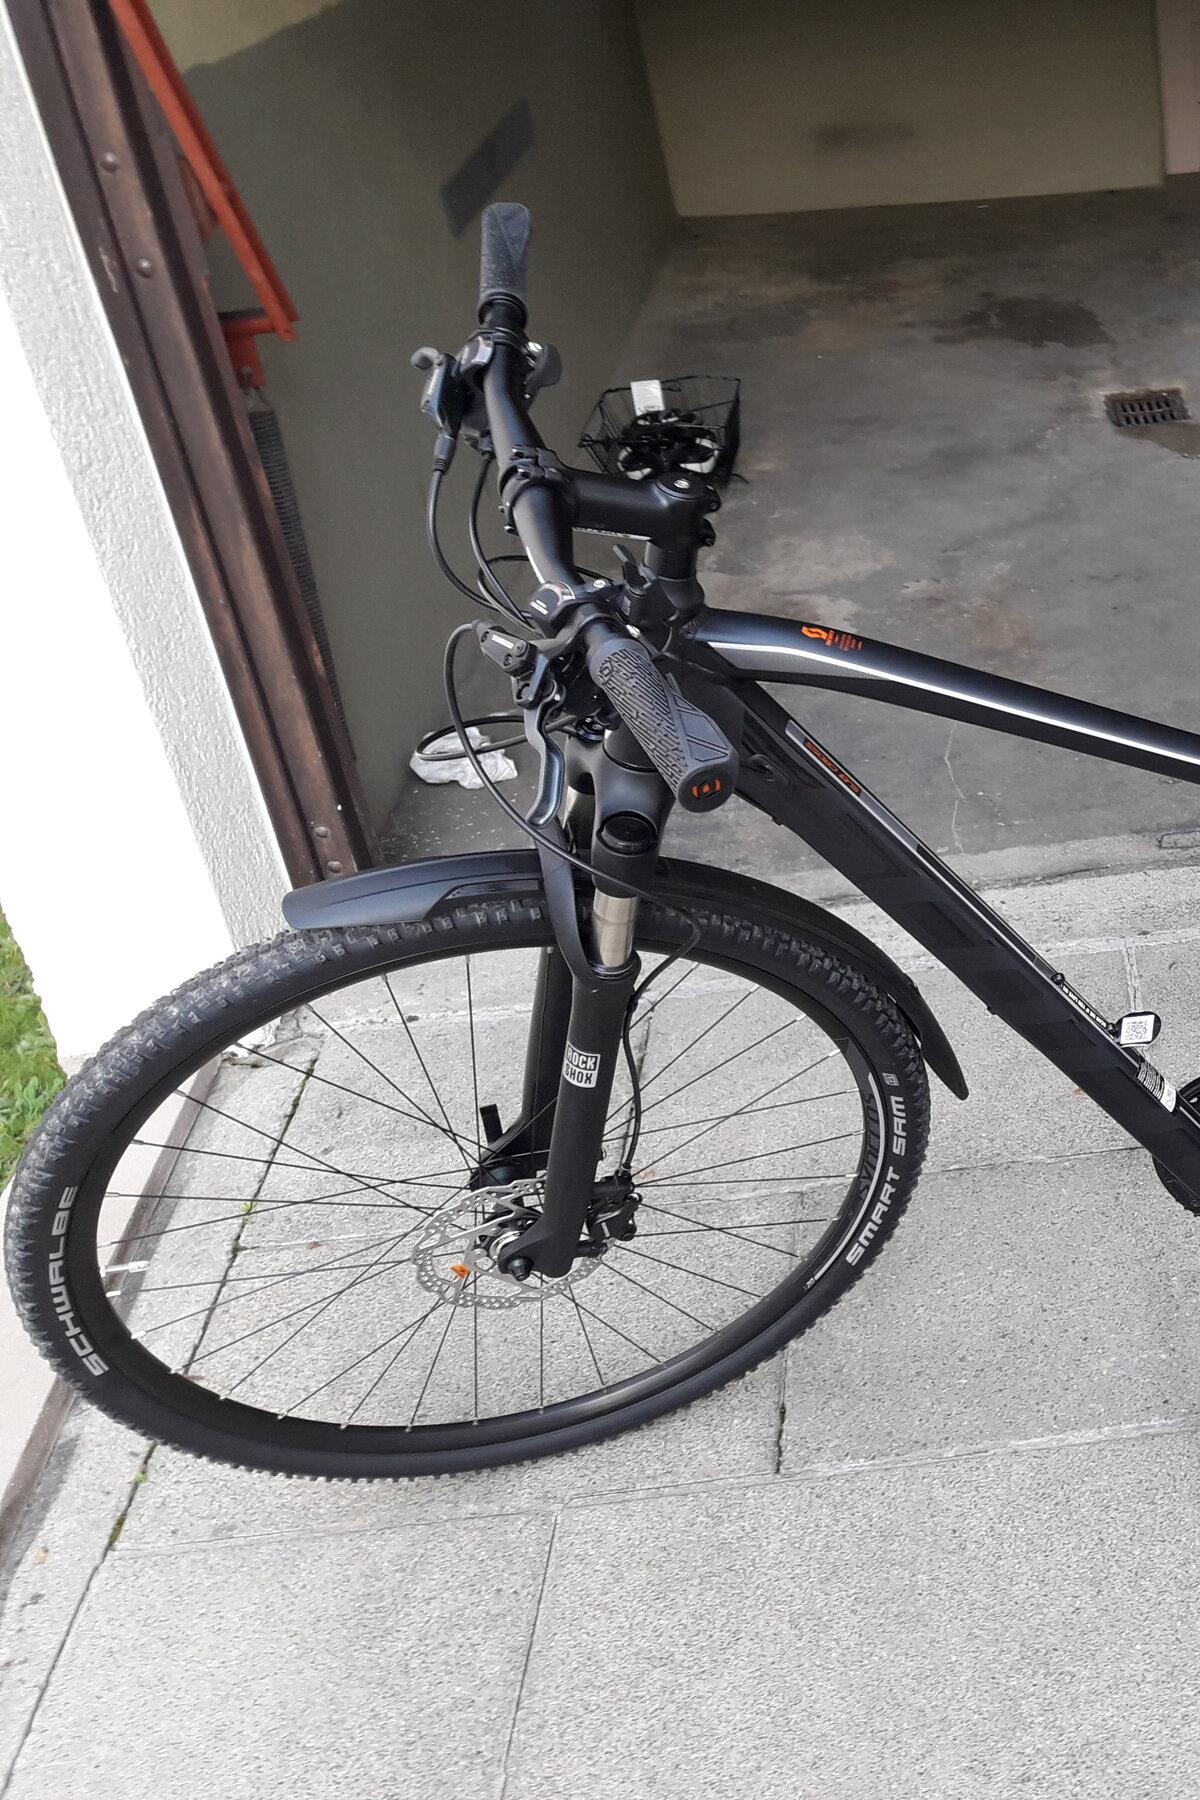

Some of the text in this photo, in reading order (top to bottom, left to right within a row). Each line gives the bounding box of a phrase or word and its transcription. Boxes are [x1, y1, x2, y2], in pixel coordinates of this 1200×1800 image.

[564, 1062, 593, 1085] SHOX
[567, 1046, 596, 1070] ROCK
[845, 1166, 900, 1266] SMART
[890, 1095, 907, 1157] SAM
[48, 1185, 110, 1376] SCHWALBE
